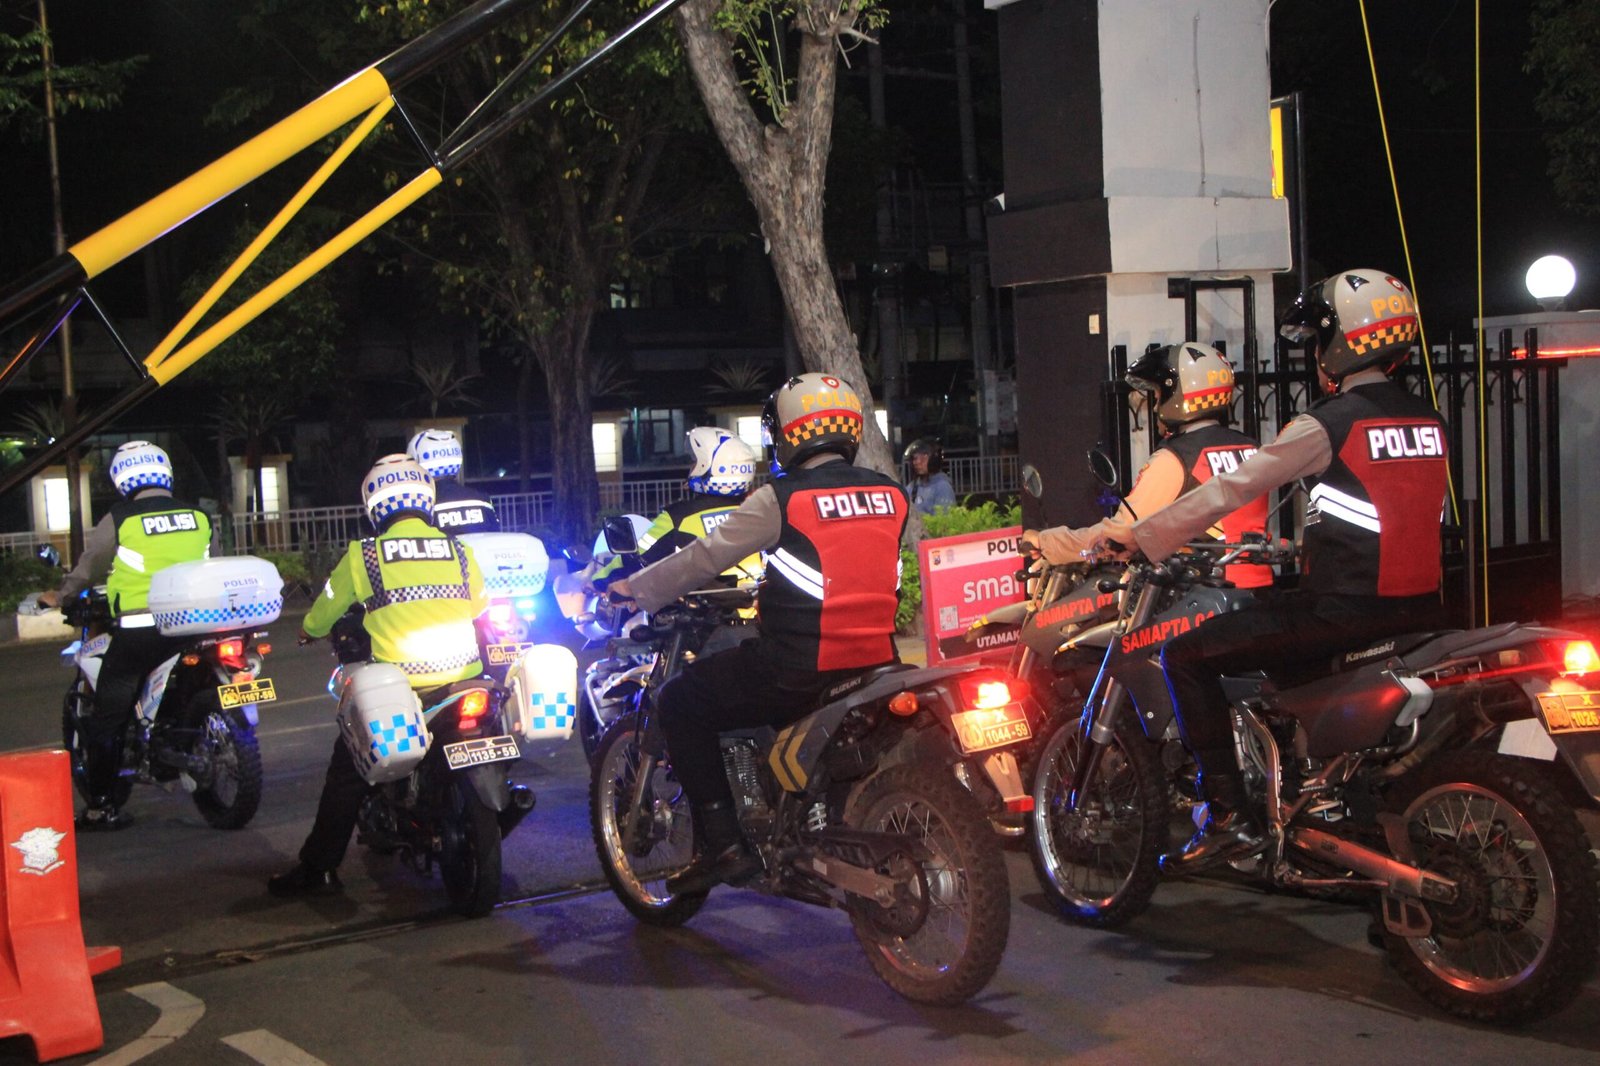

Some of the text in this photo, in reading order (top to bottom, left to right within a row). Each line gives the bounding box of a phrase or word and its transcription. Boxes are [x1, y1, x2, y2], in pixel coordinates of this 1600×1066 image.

[1368, 427, 1443, 460] POLISI
[118, 454, 155, 470] POLISI
[377, 471, 422, 489] POLISI
[817, 491, 896, 518] POLISI
[143, 513, 197, 534] POLISI
[438, 509, 484, 528] POLISI
[383, 538, 452, 561] POLISI
[223, 577, 259, 588] POLISI
[1035, 597, 1095, 629] SAMAPTA
[1121, 616, 1191, 654] SAMAPTA
[1345, 640, 1395, 663] Kawasaki
[471, 746, 516, 761] 1135-59
[485, 739, 495, 748] X
